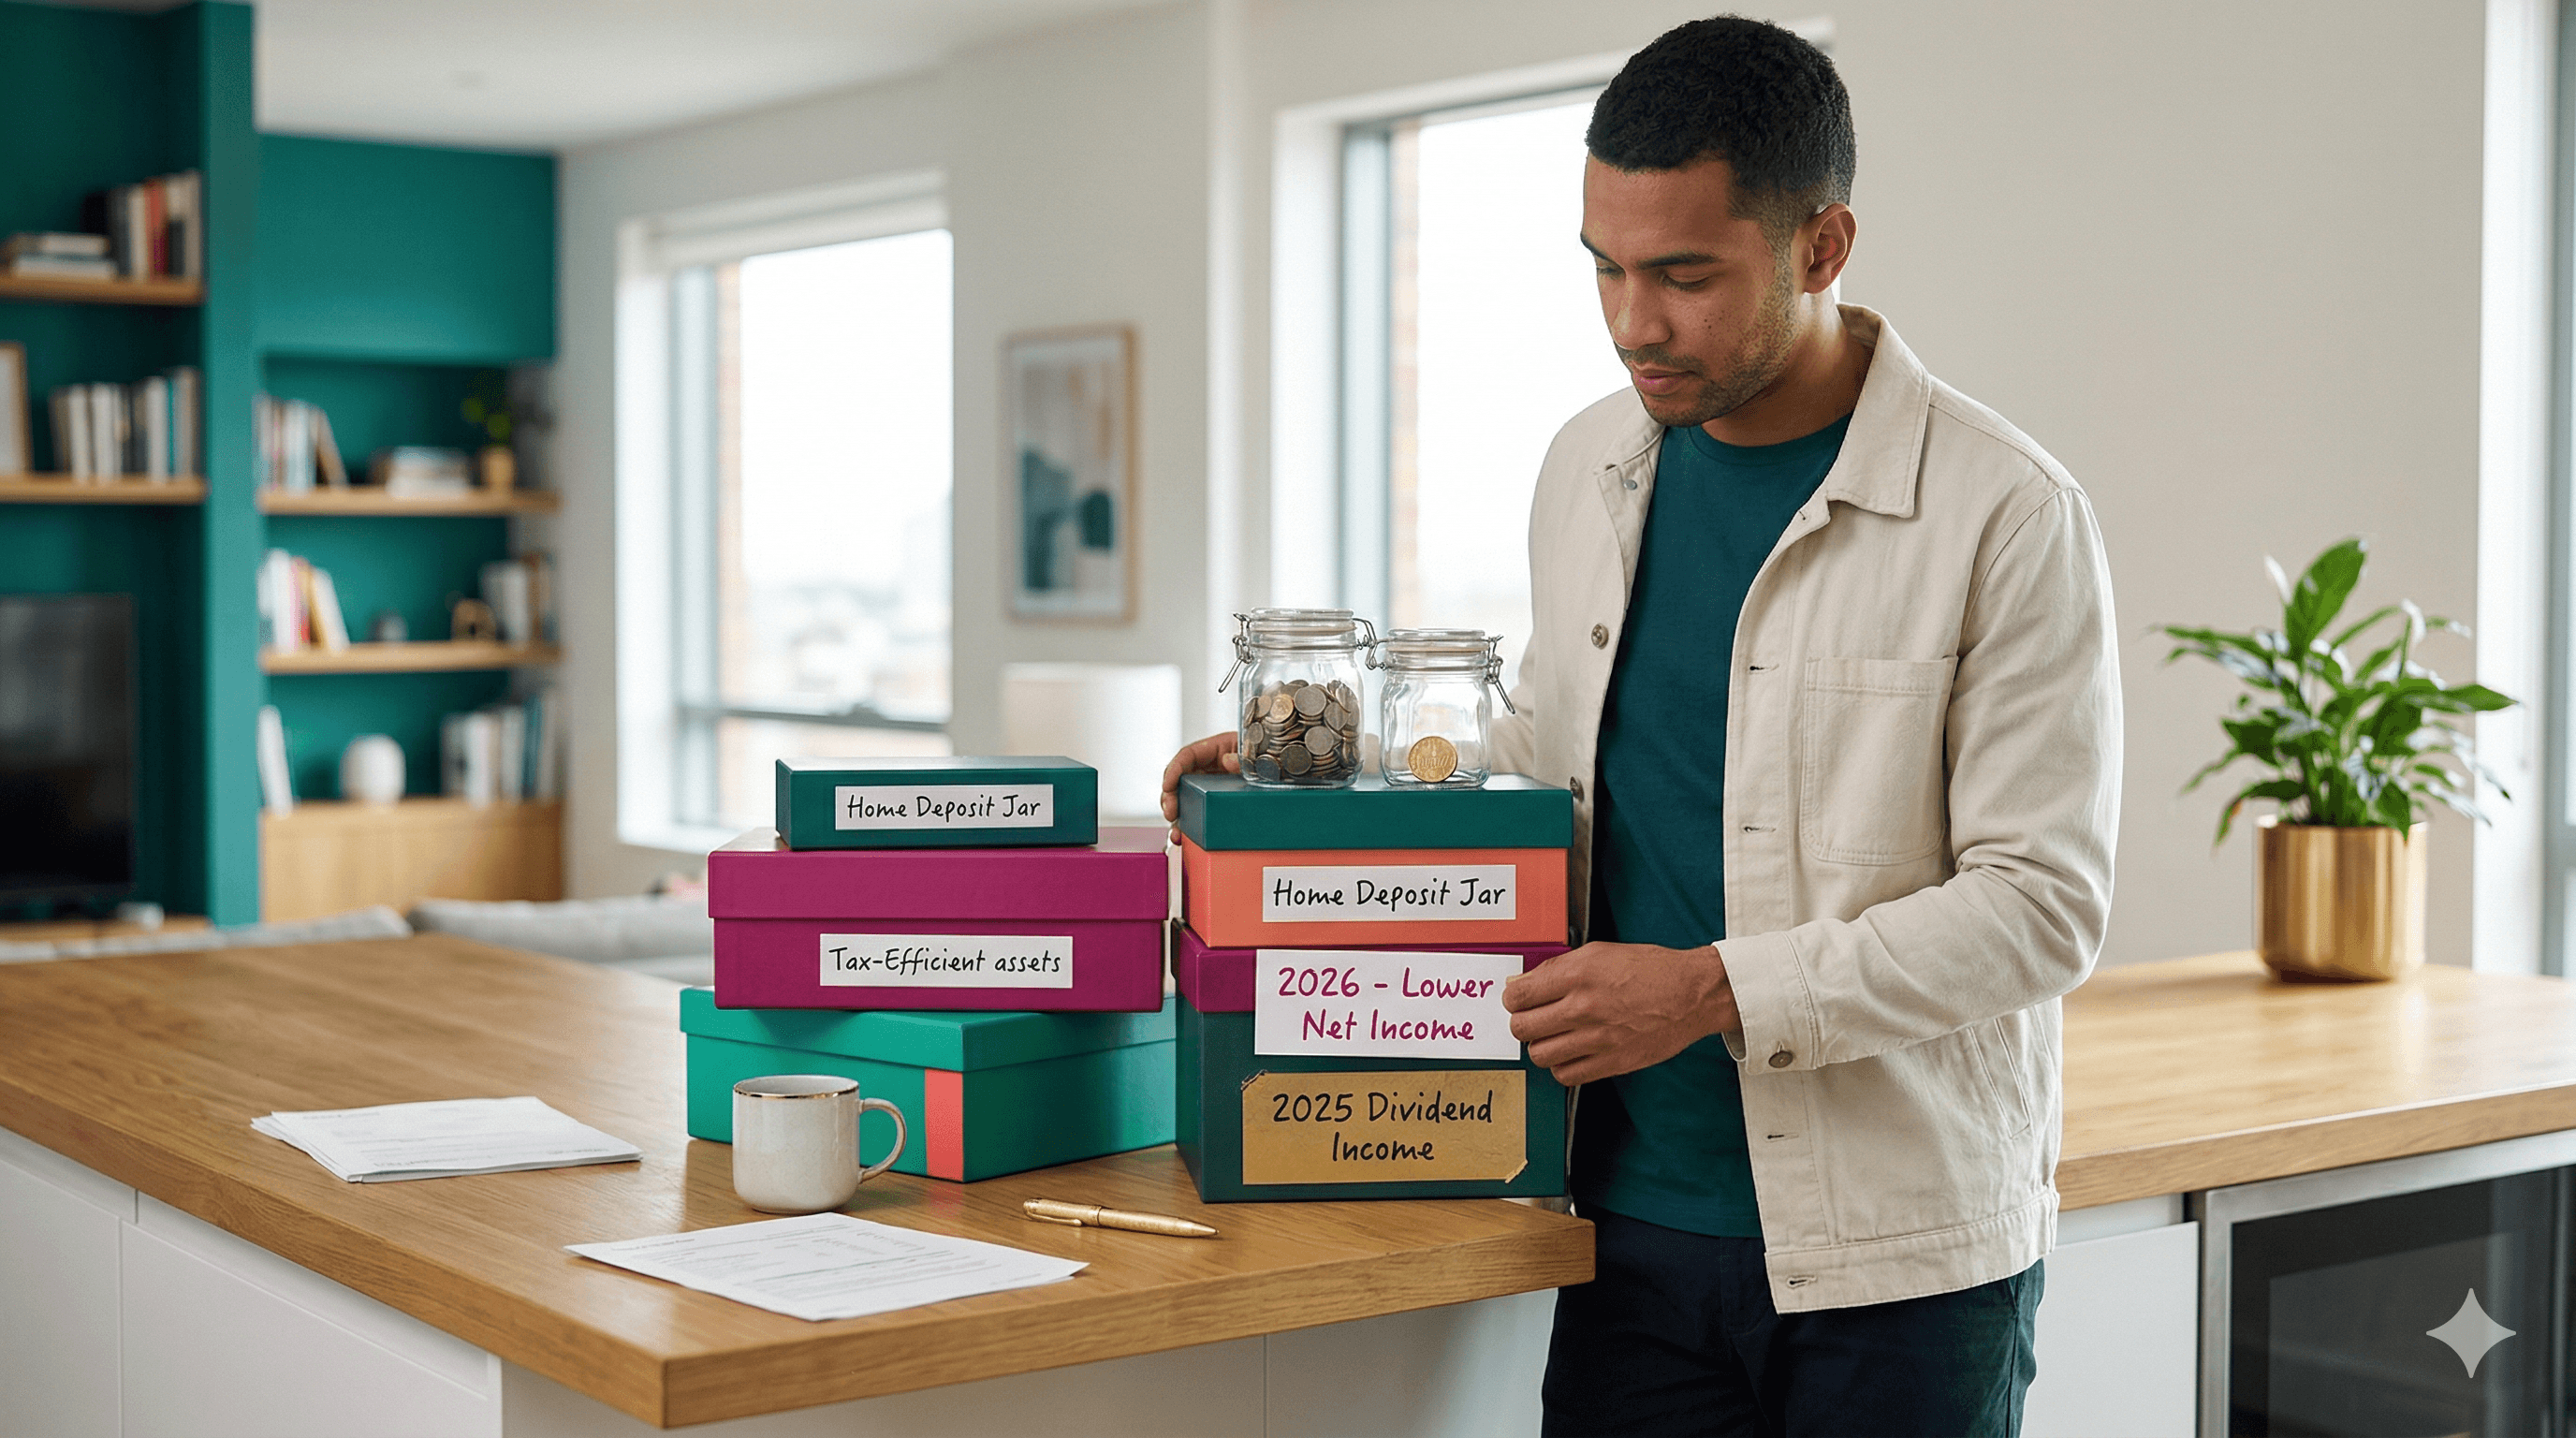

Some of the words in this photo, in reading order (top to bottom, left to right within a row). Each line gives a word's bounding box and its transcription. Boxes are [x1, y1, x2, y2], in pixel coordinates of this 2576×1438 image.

[847, 794, 908, 819] Home
[915, 793, 995, 823] Deposit
[1002, 794, 1041, 818] Jar
[1272, 877, 1345, 907] Home
[1356, 877, 1451, 913] Deposit
[1459, 877, 1506, 906] Jar
[828, 946, 986, 976] Tax-Efficient
[994, 949, 1061, 973] assets
[1279, 967, 1360, 998] 2026
[1402, 966, 1494, 999] Lower
[1302, 1008, 1357, 1041] Net
[1370, 1008, 1474, 1041] Income
[1272, 1093, 1354, 1123] 2025
[1367, 1089, 1493, 1124] Dividend
[1332, 1131, 1435, 1162] Income
